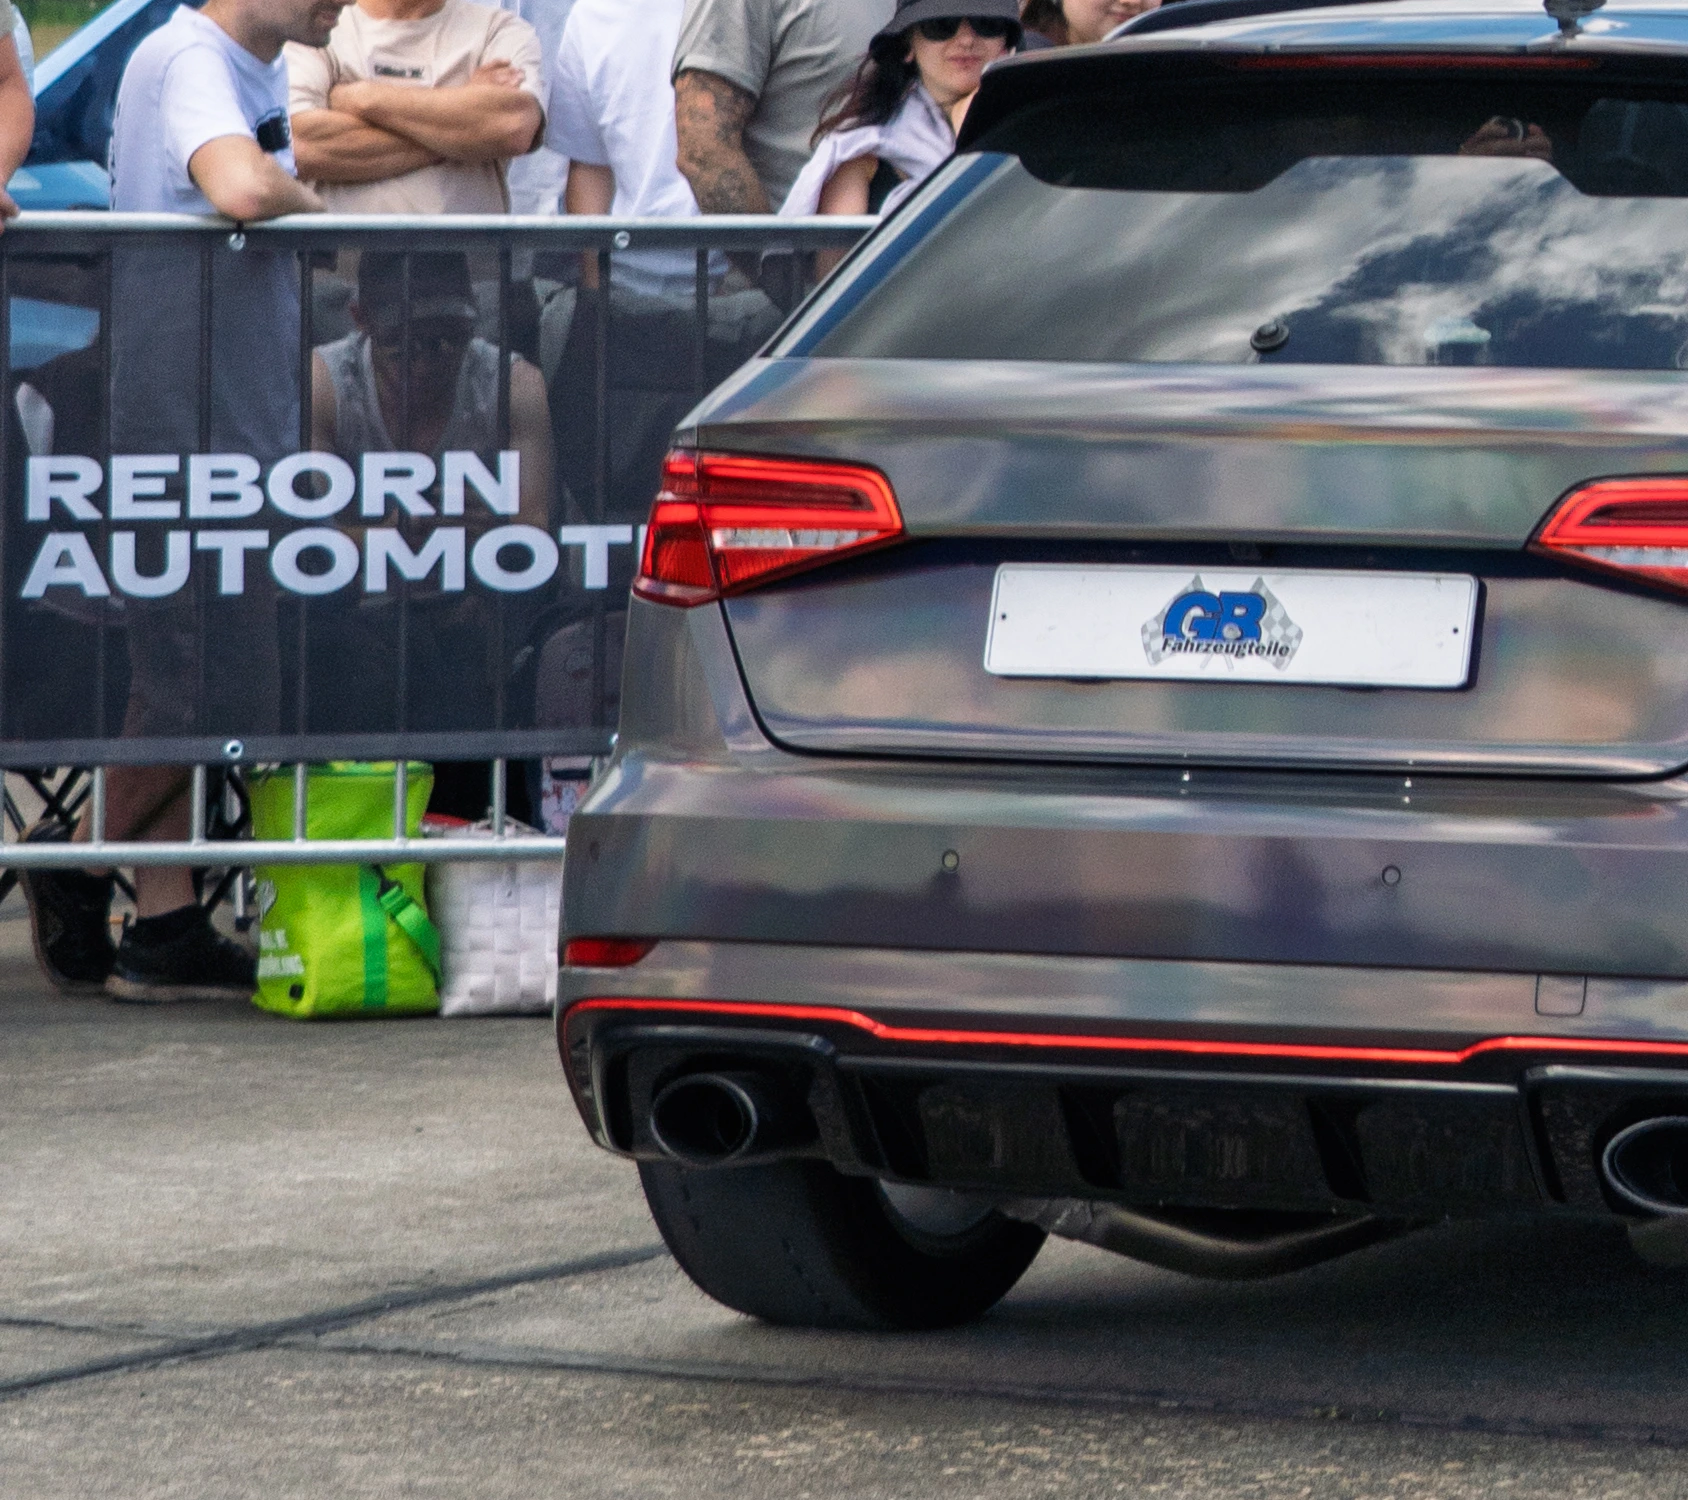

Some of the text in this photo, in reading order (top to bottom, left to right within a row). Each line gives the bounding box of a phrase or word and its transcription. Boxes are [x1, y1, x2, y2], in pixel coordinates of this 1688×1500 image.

[25, 450, 521, 522] REBORN
[20, 523, 647, 599] AUTOMOT
[1162, 636, 1290, 658] Fahrzeugteile
[1163, 590, 1266, 642] GB
